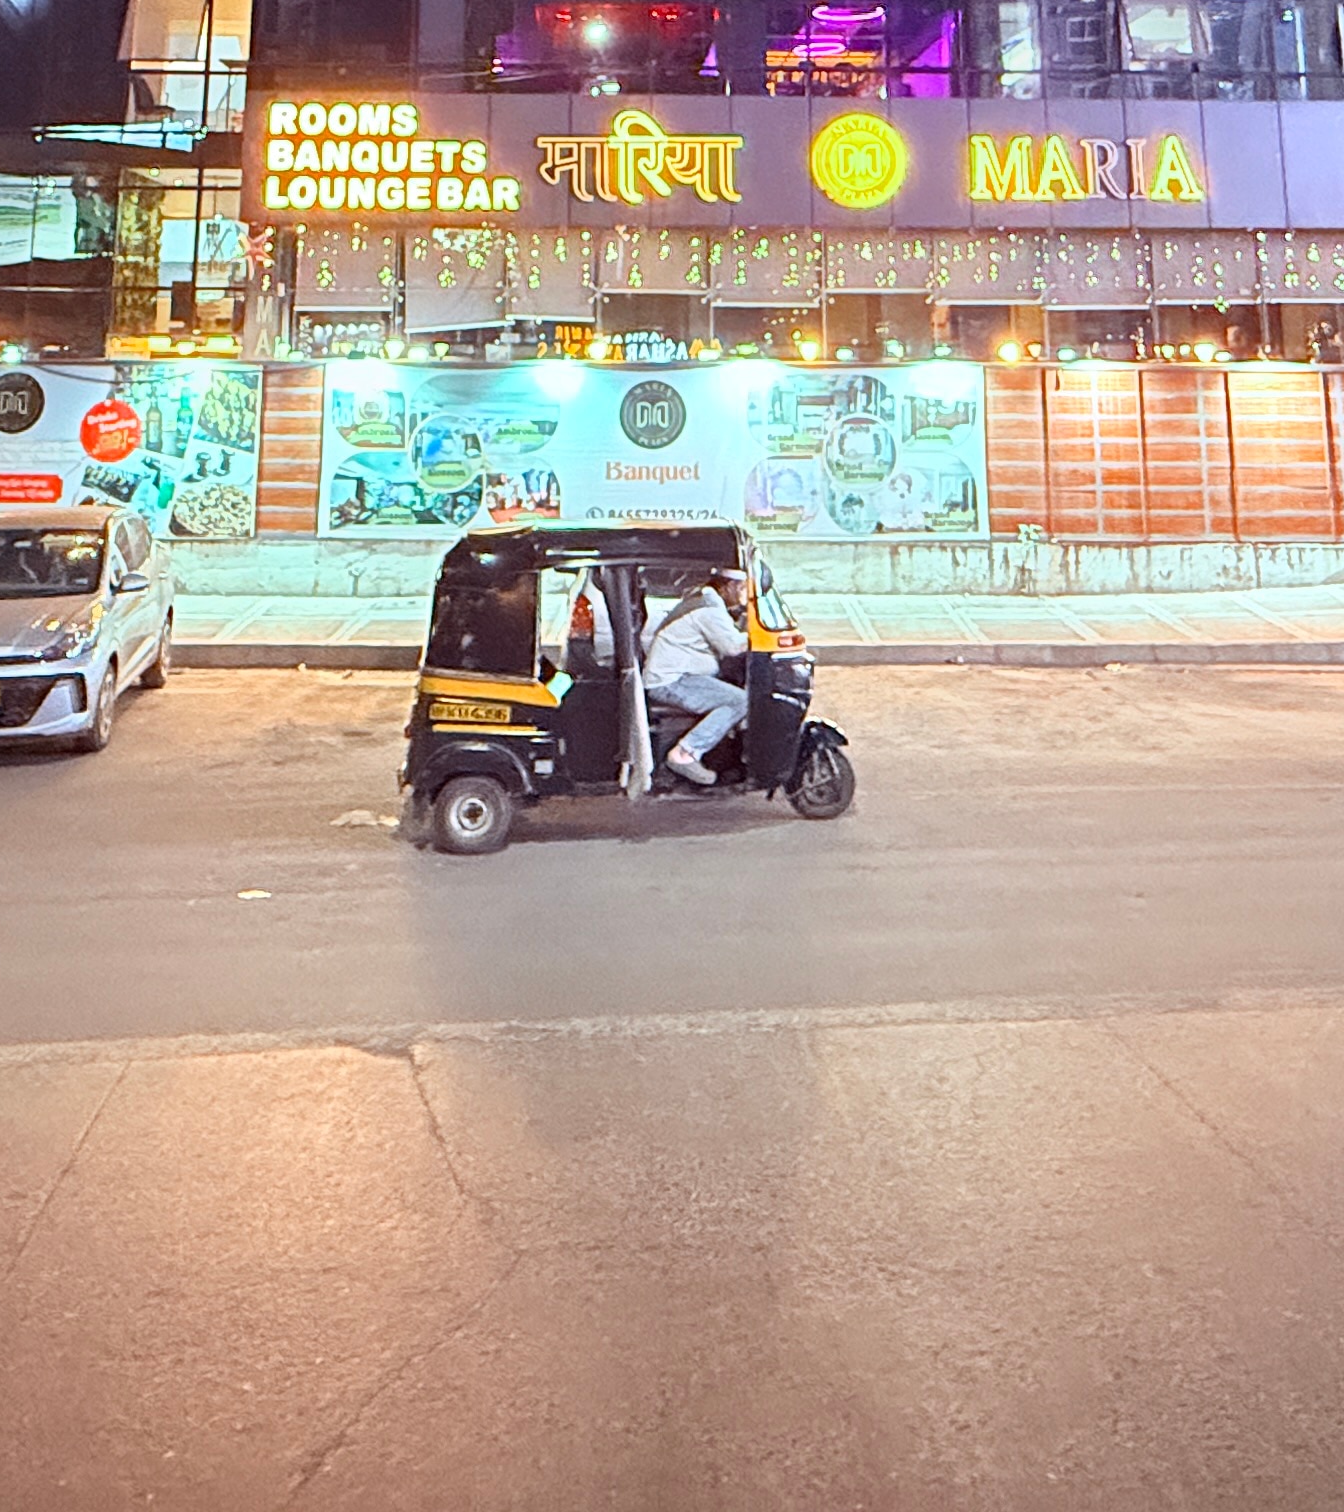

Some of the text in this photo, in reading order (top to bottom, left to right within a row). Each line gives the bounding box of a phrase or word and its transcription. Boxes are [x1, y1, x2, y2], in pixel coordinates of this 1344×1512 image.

[269, 101, 419, 137] ROOMS
[266, 138, 488, 175] BANQUETS
[536, 108, 744, 206] मारिया
[969, 133, 1205, 202] MARIA
[263, 174, 522, 212] LOUNGE BAR
[605, 460, 701, 485] Banquet
